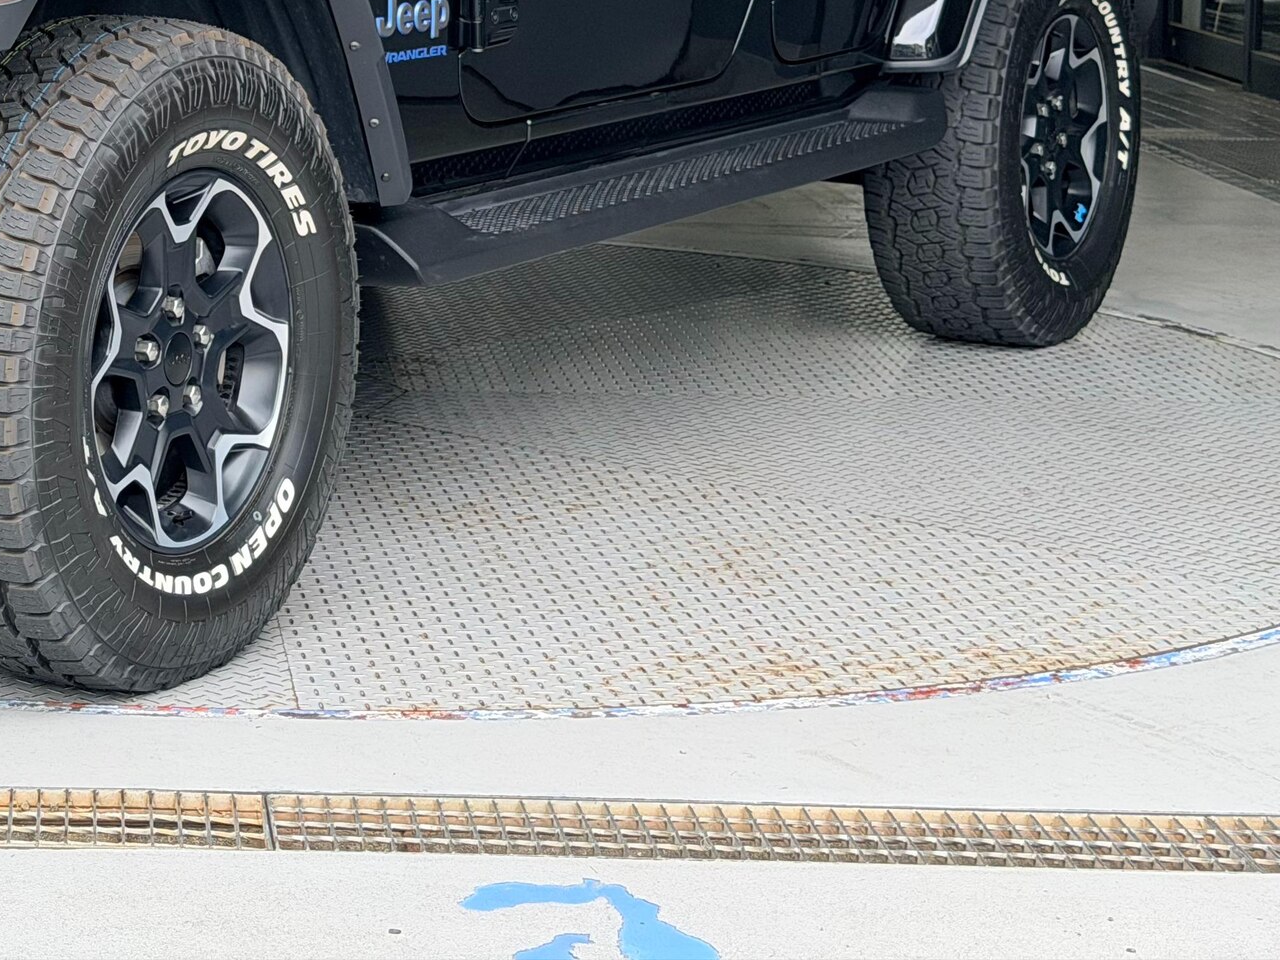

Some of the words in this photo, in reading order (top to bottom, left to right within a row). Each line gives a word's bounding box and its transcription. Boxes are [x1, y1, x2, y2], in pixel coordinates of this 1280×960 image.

[167, 129, 248, 168] TOYO
[243, 138, 318, 237] TIRES
[109, 535, 230, 595] COUNTRY
[229, 477, 296, 577] OPEN
